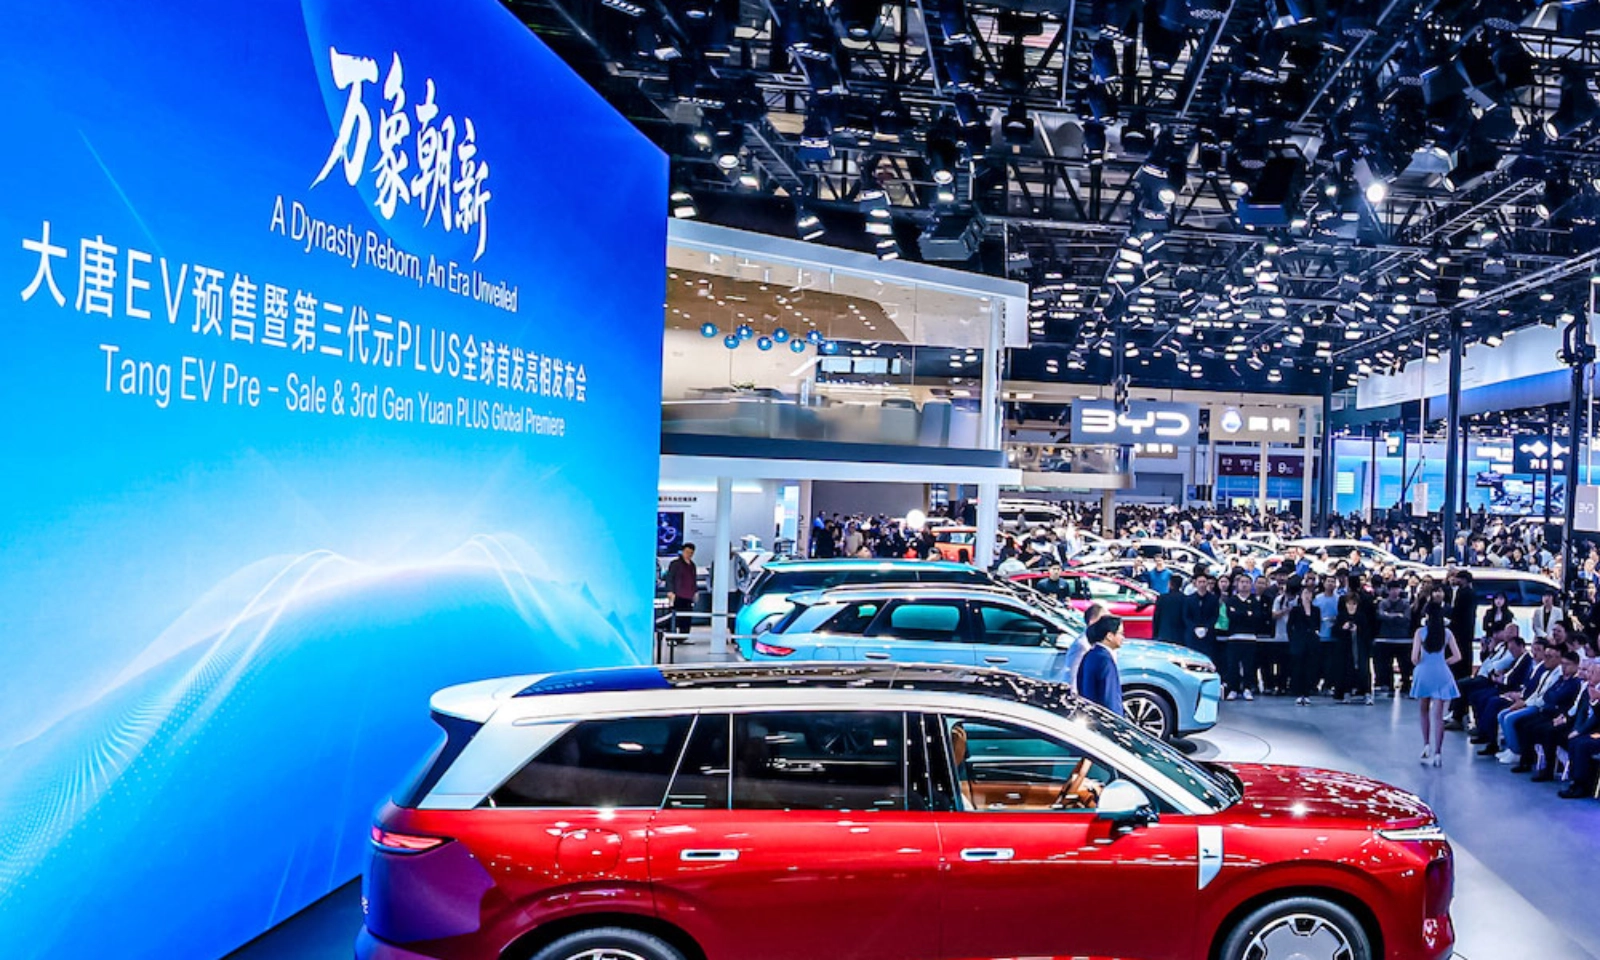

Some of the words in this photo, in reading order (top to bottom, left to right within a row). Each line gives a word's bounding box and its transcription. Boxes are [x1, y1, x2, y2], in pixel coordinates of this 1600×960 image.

[309, 46, 492, 263] 万象朝新
[270, 195, 286, 236] A
[291, 201, 362, 268] Dynasty
[365, 231, 424, 288] Reborn,
[427, 254, 446, 288] An
[449, 261, 470, 297] Era
[473, 270, 519, 313] Unveiled
[99, 343, 171, 408] Tang
[180, 356, 216, 402] EV
[223, 362, 261, 407] Pre
[285, 372, 327, 416] Sale
[331, 379, 345, 416] &
[350, 382, 377, 419] 3rd
[382, 386, 414, 423] Gen
[418, 390, 453, 427] Yuan
[456, 397, 489, 430] PLUS
[491, 401, 523, 435] Global
[526, 406, 566, 438] Premiere
[1081, 408, 1191, 436] BYD
[1578, 503, 1596, 515] BYD
